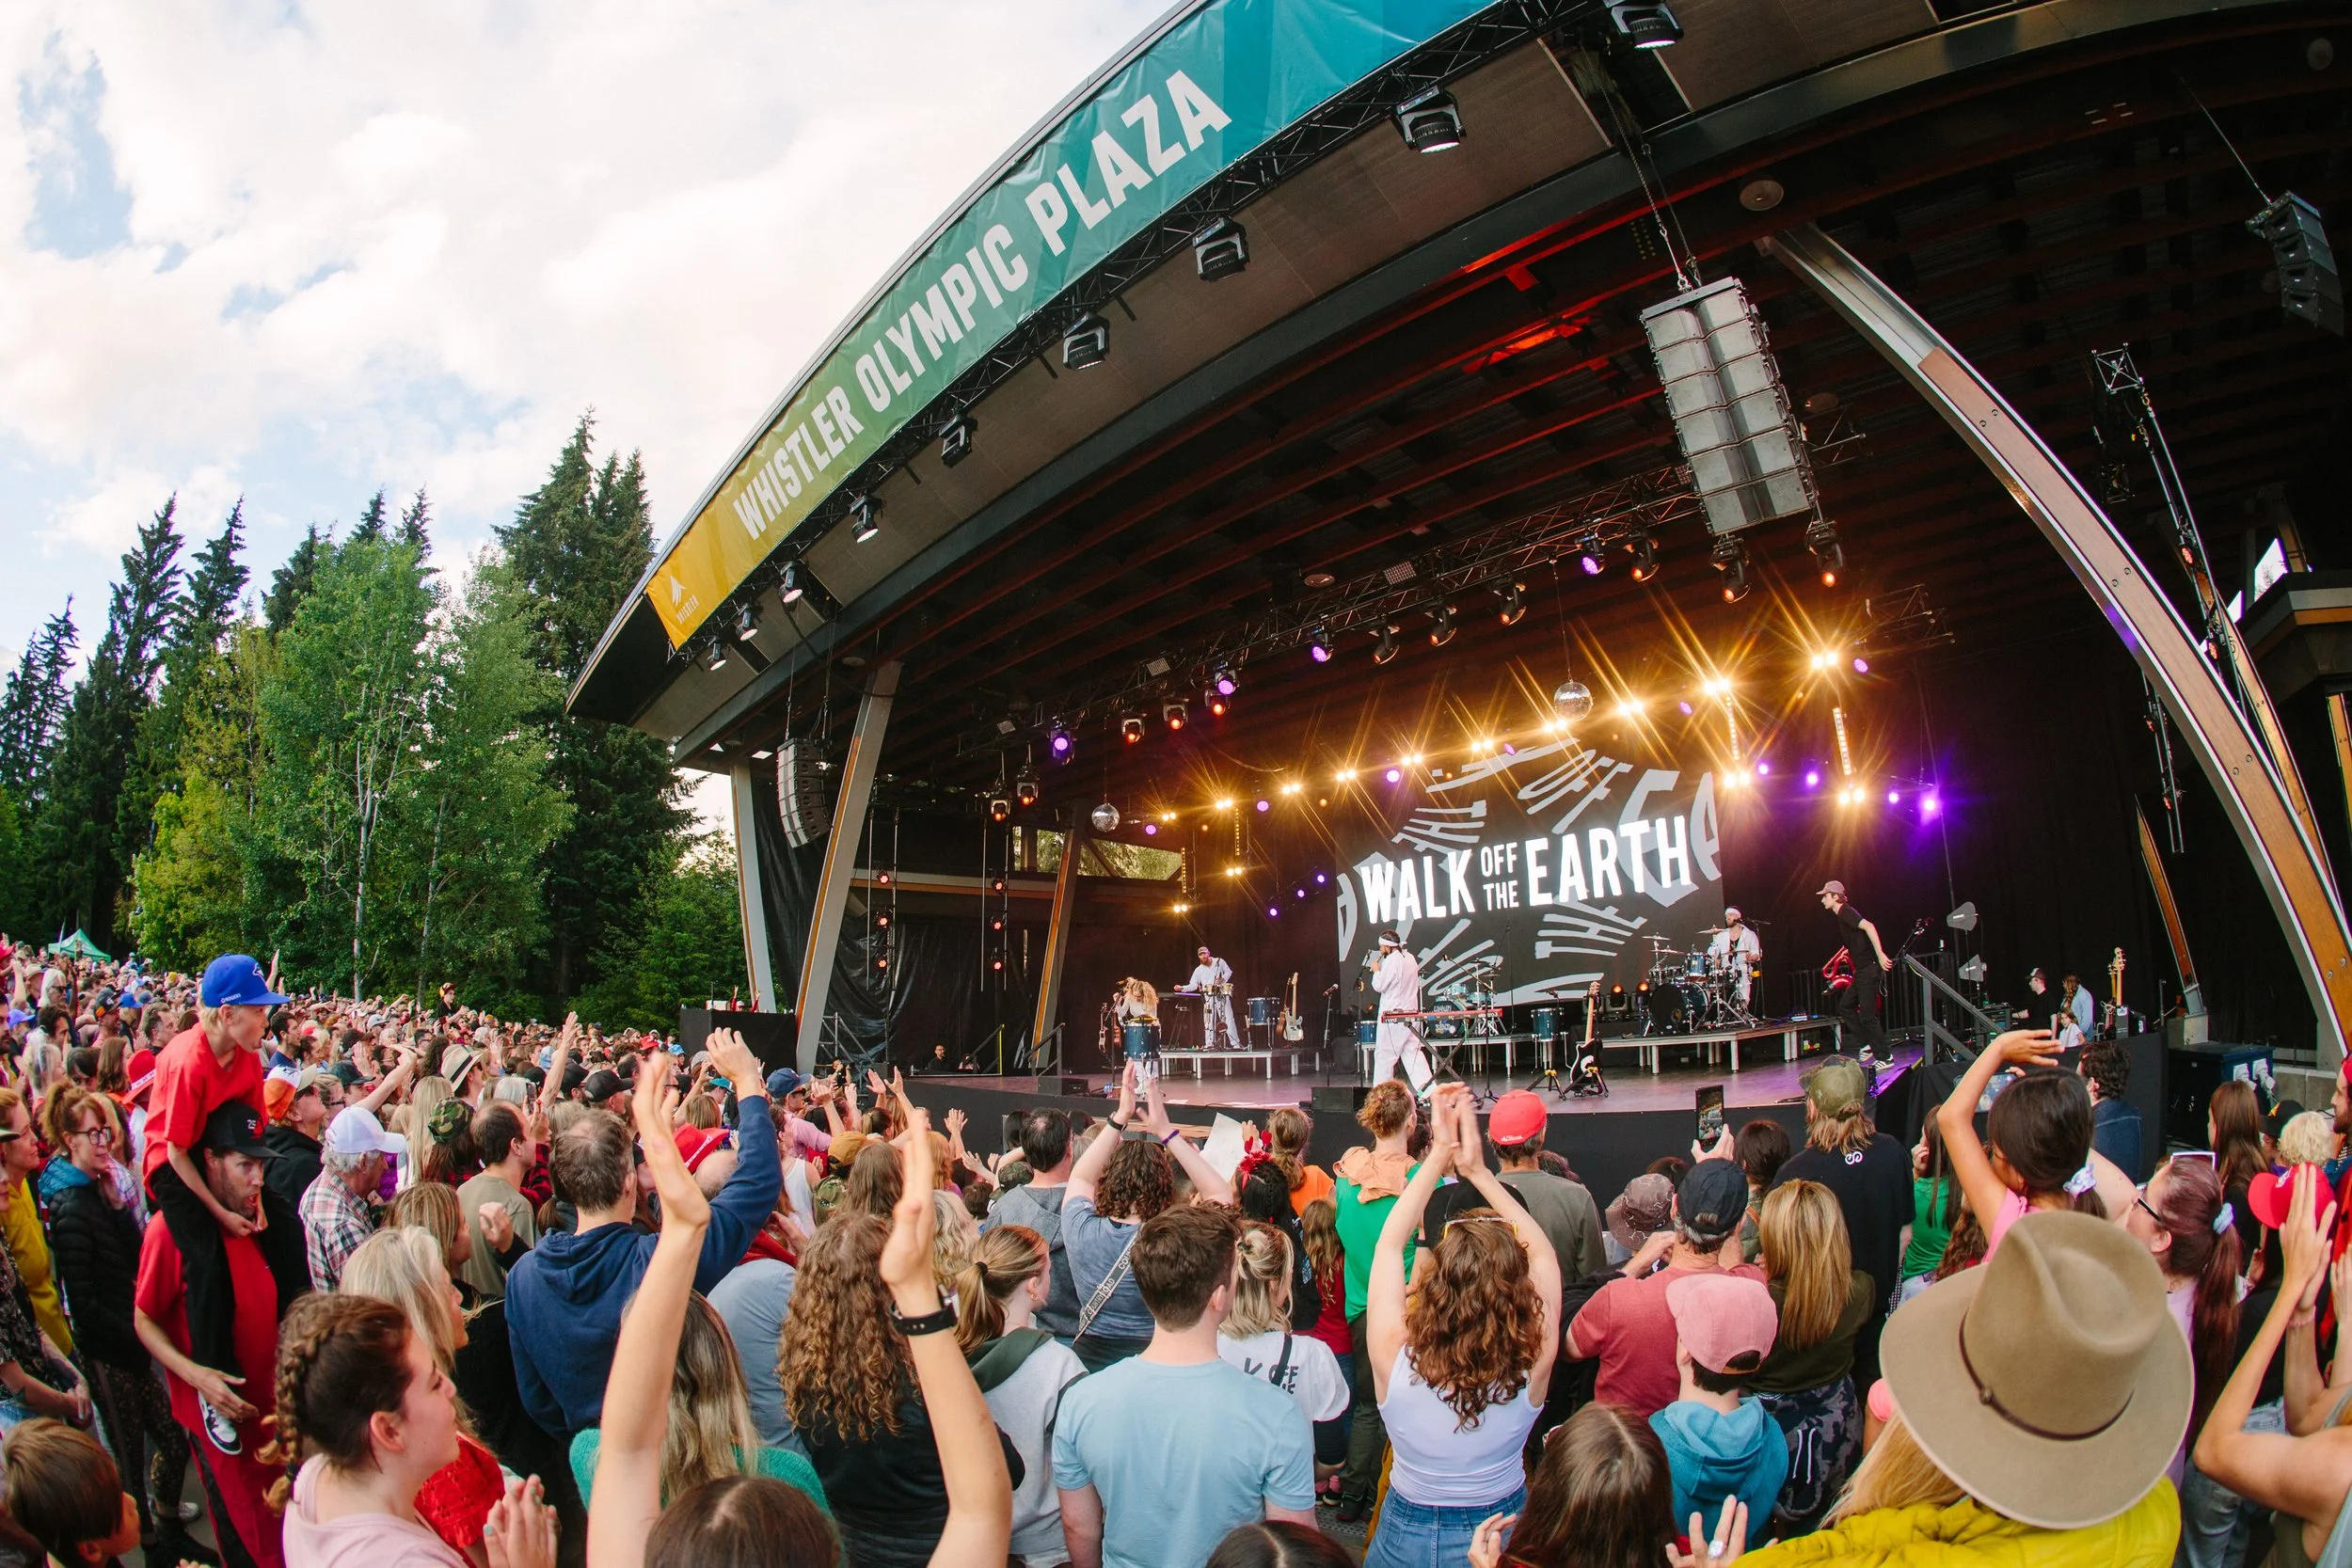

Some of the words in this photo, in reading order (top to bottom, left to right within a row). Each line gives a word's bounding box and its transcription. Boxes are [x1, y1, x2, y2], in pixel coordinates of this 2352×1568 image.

[732, 386, 865, 541] WHISTLER
[855, 223, 1028, 413] OLYMPIC
[1025, 69, 1233, 257] PLAZA
[1360, 848, 1475, 924] WALK
[1480, 842, 1518, 878] OFF
[1483, 883, 1520, 911] THE
[1525, 815, 1693, 906] EARTH
